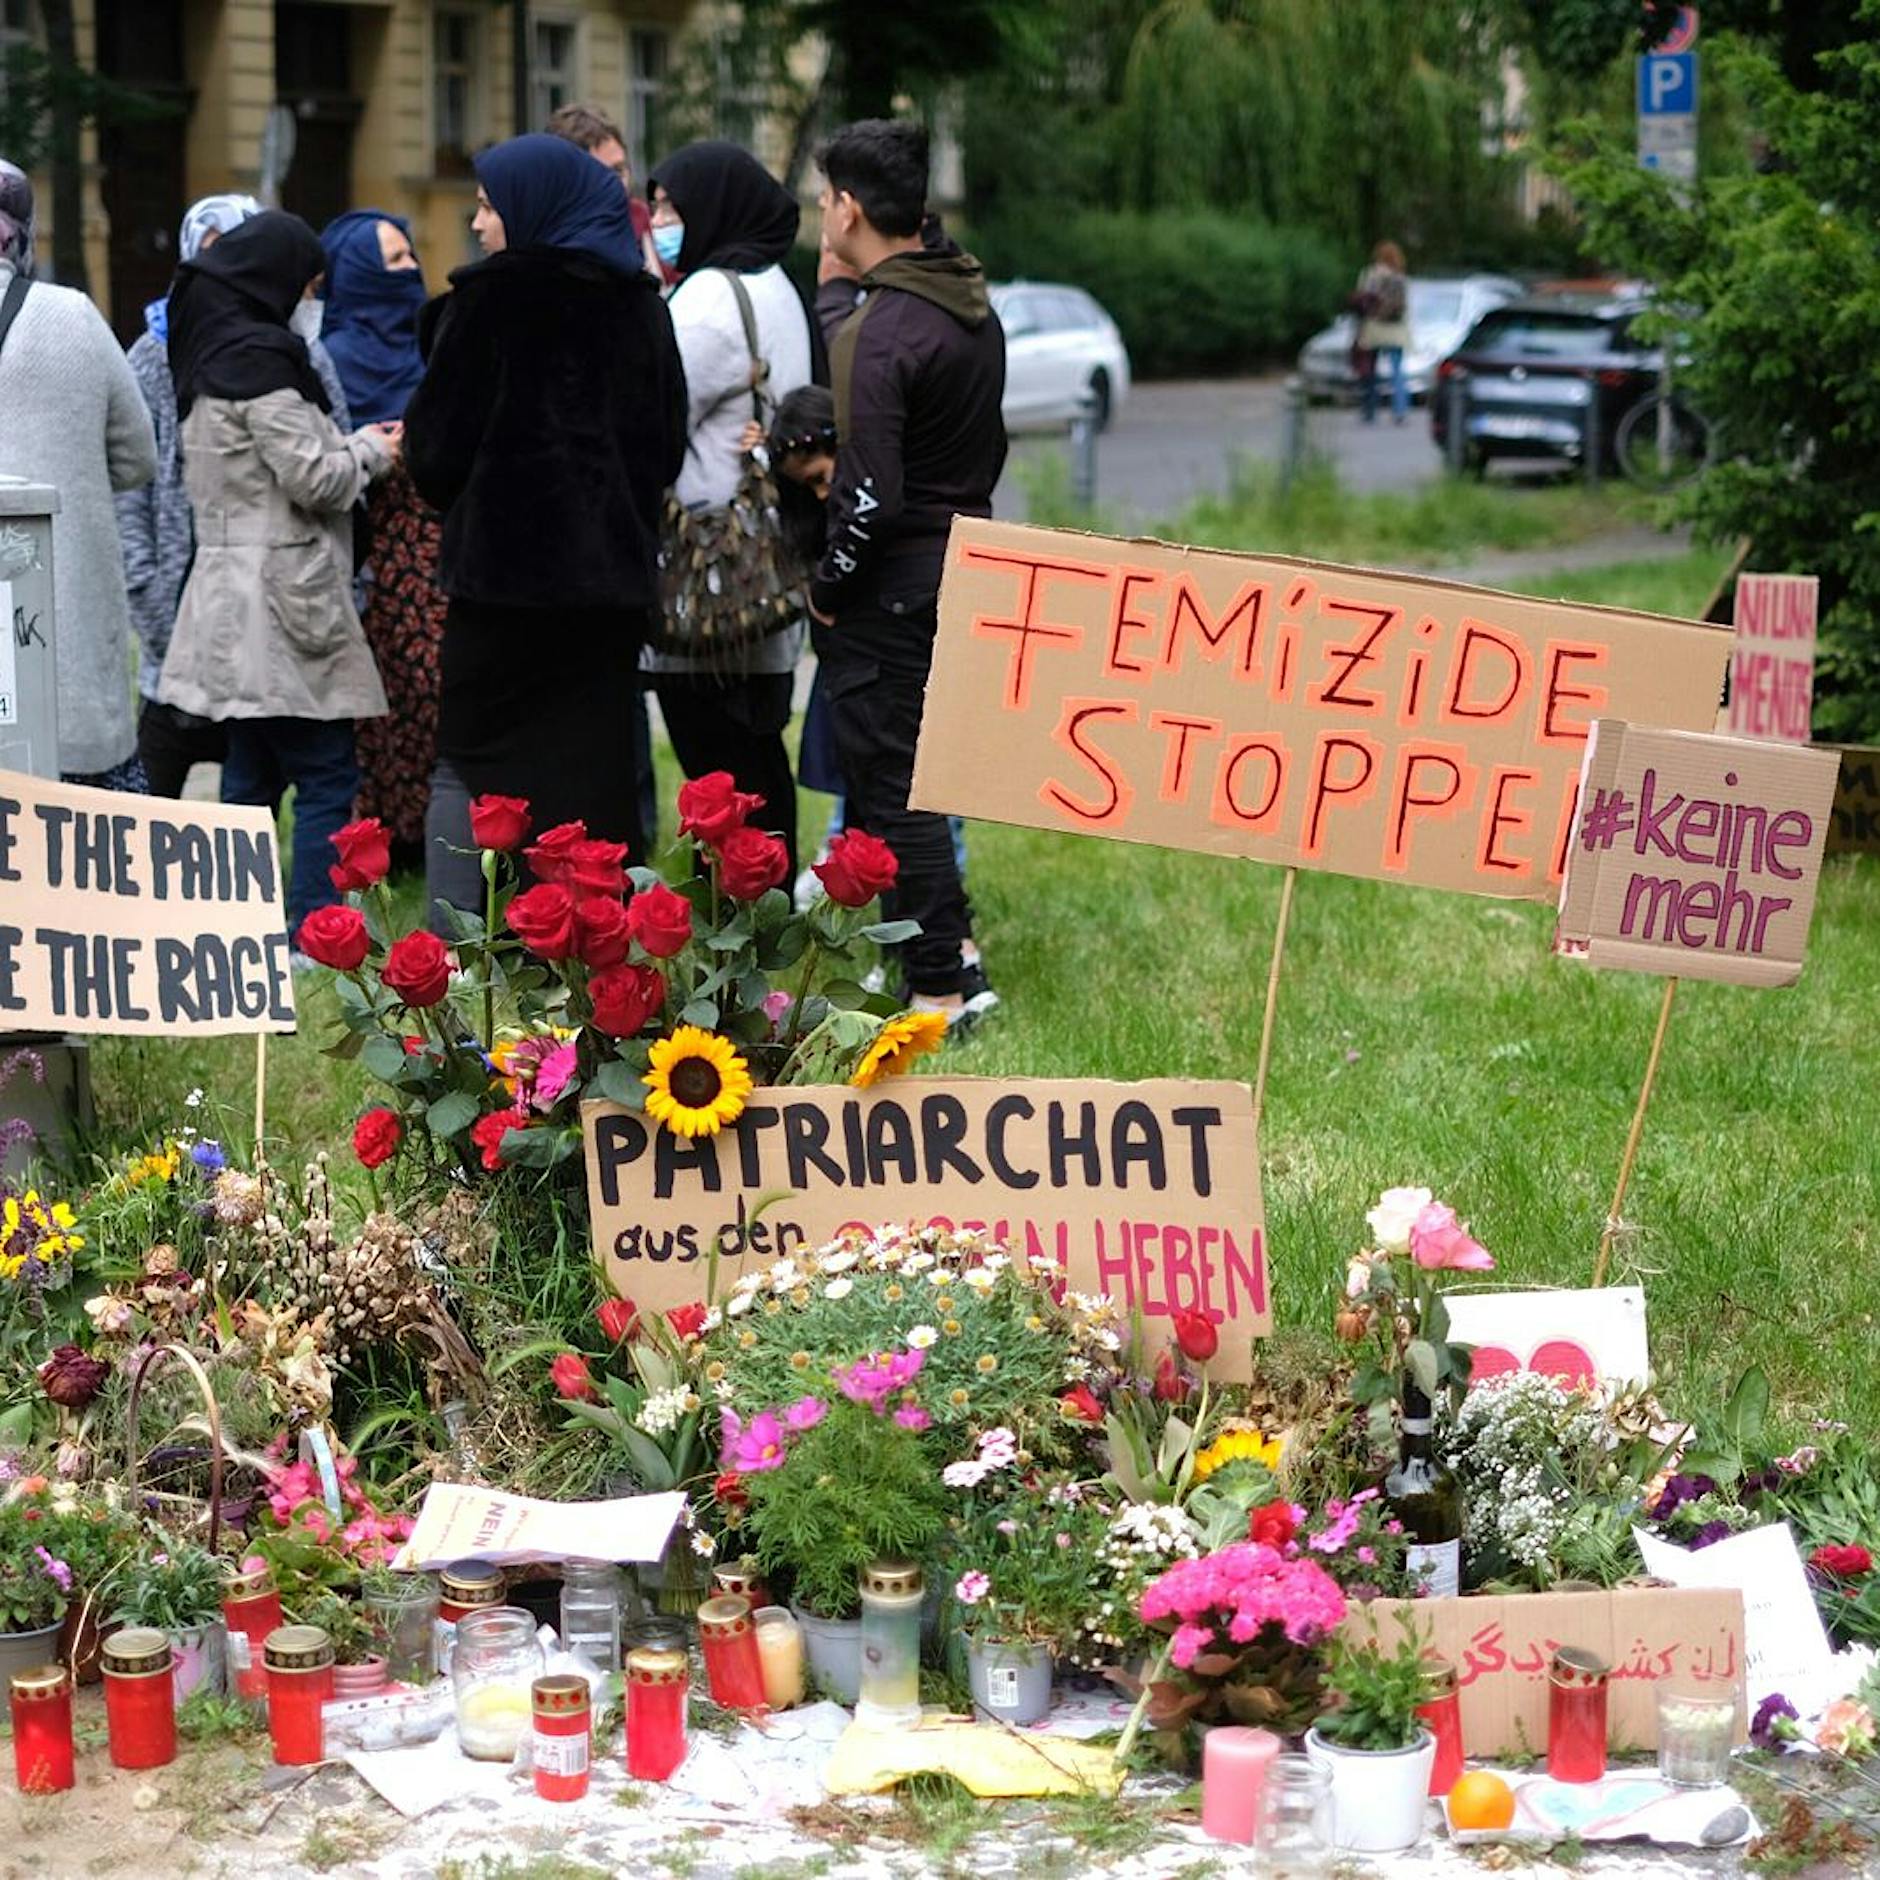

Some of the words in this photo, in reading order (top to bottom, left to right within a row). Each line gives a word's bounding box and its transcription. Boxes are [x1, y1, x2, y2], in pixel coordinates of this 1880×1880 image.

[34, 803, 140, 897] THE
[150, 819, 276, 902] PAIN
[1580, 768, 1813, 880] #keine
[1620, 870, 1793, 953] mehr
[35, 927, 150, 1021] THE
[154, 932, 297, 1023] RAGE
[595, 1093, 1222, 1207] PATRIARCHAT
[613, 1224, 700, 1262] aus
[717, 1193, 806, 1257] den
[1095, 1218, 1267, 1325] HEBEN
[471, 1501, 506, 1548] NEIN
